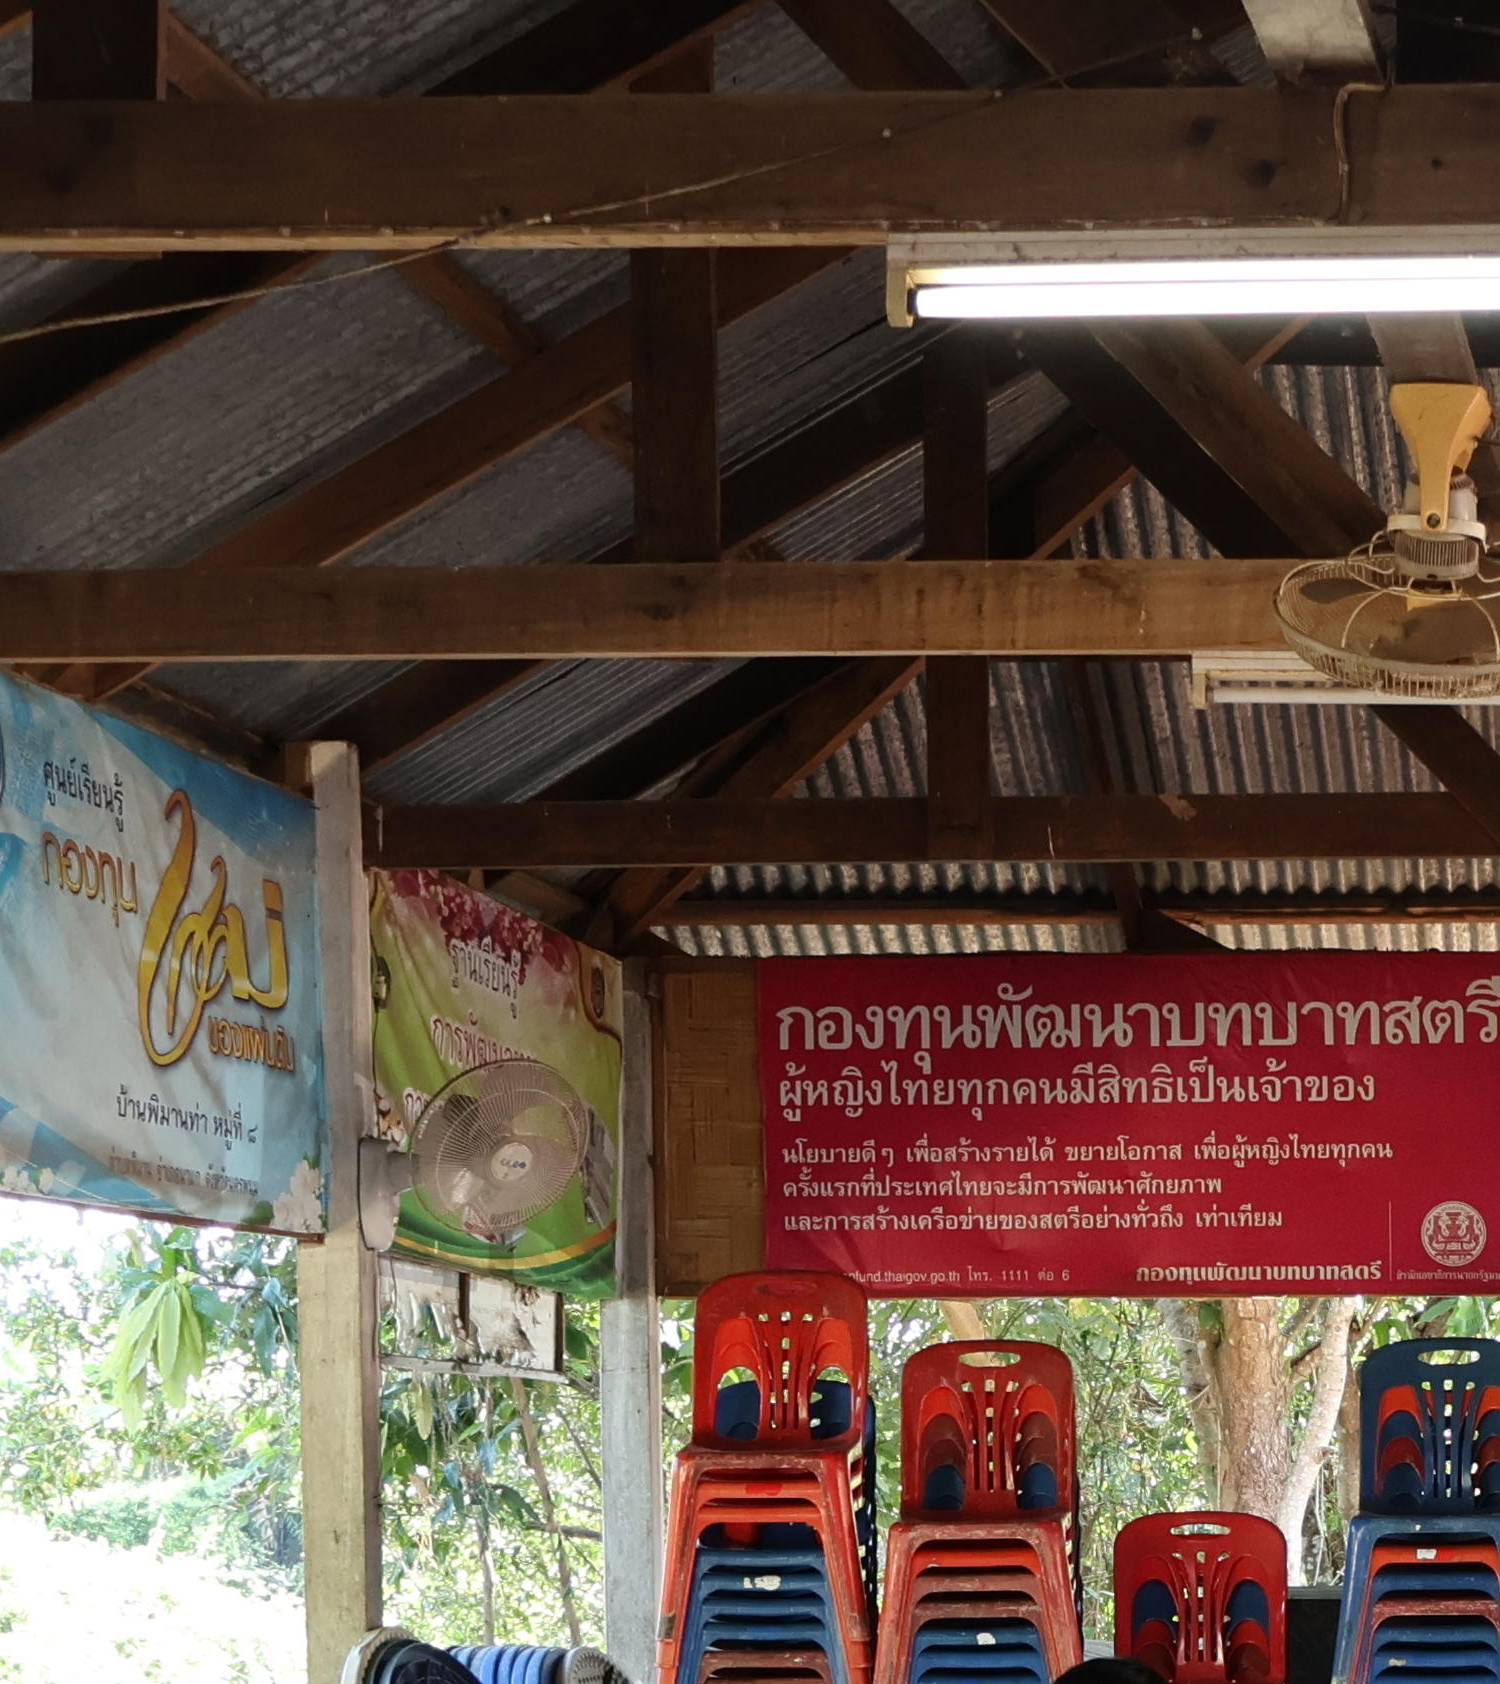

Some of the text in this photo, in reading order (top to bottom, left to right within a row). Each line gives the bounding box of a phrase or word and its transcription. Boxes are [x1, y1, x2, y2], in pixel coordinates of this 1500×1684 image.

[43, 757, 125, 834] ศูนย์เรียนรู้
[41, 831, 139, 929] กองทุน
[207, 1014, 296, 1074] ของแผ่นดิน
[779, 1056, 1376, 1121] ผู้หญิงไทยทุกคนมีสิทธิเป็นเจ้าของ
[116, 1083, 209, 1134] บ้านพิมานท่า
[213, 1102, 244, 1151] หมู่ที่
[906, 1133, 1055, 1163] เพื่อสร้างรายได้
[1064, 1135, 1183, 1162] ขยายโอกาส
[1193, 1131, 1394, 1168] เพื่อผู้หญิงไทยทุกคน
[783, 1166, 1222, 1198] ครั้งแรกที่ประเทศไทยจะมีการพัฒนาศักยภาพ
[784, 1199, 1283, 1231] และการสร้างเครือข่ายของสตรีอย่างทั่วถึง เท่าเทียม
[968, 1266, 993, 1282] โทร.
[1001, 1270, 1029, 1282] 1111
[1037, 1266, 1055, 1282] ต่อ
[1061, 1269, 1071, 1282] 6
[1136, 1260, 1383, 1286] กองทุนพัฒนาบทบาทสตรี
